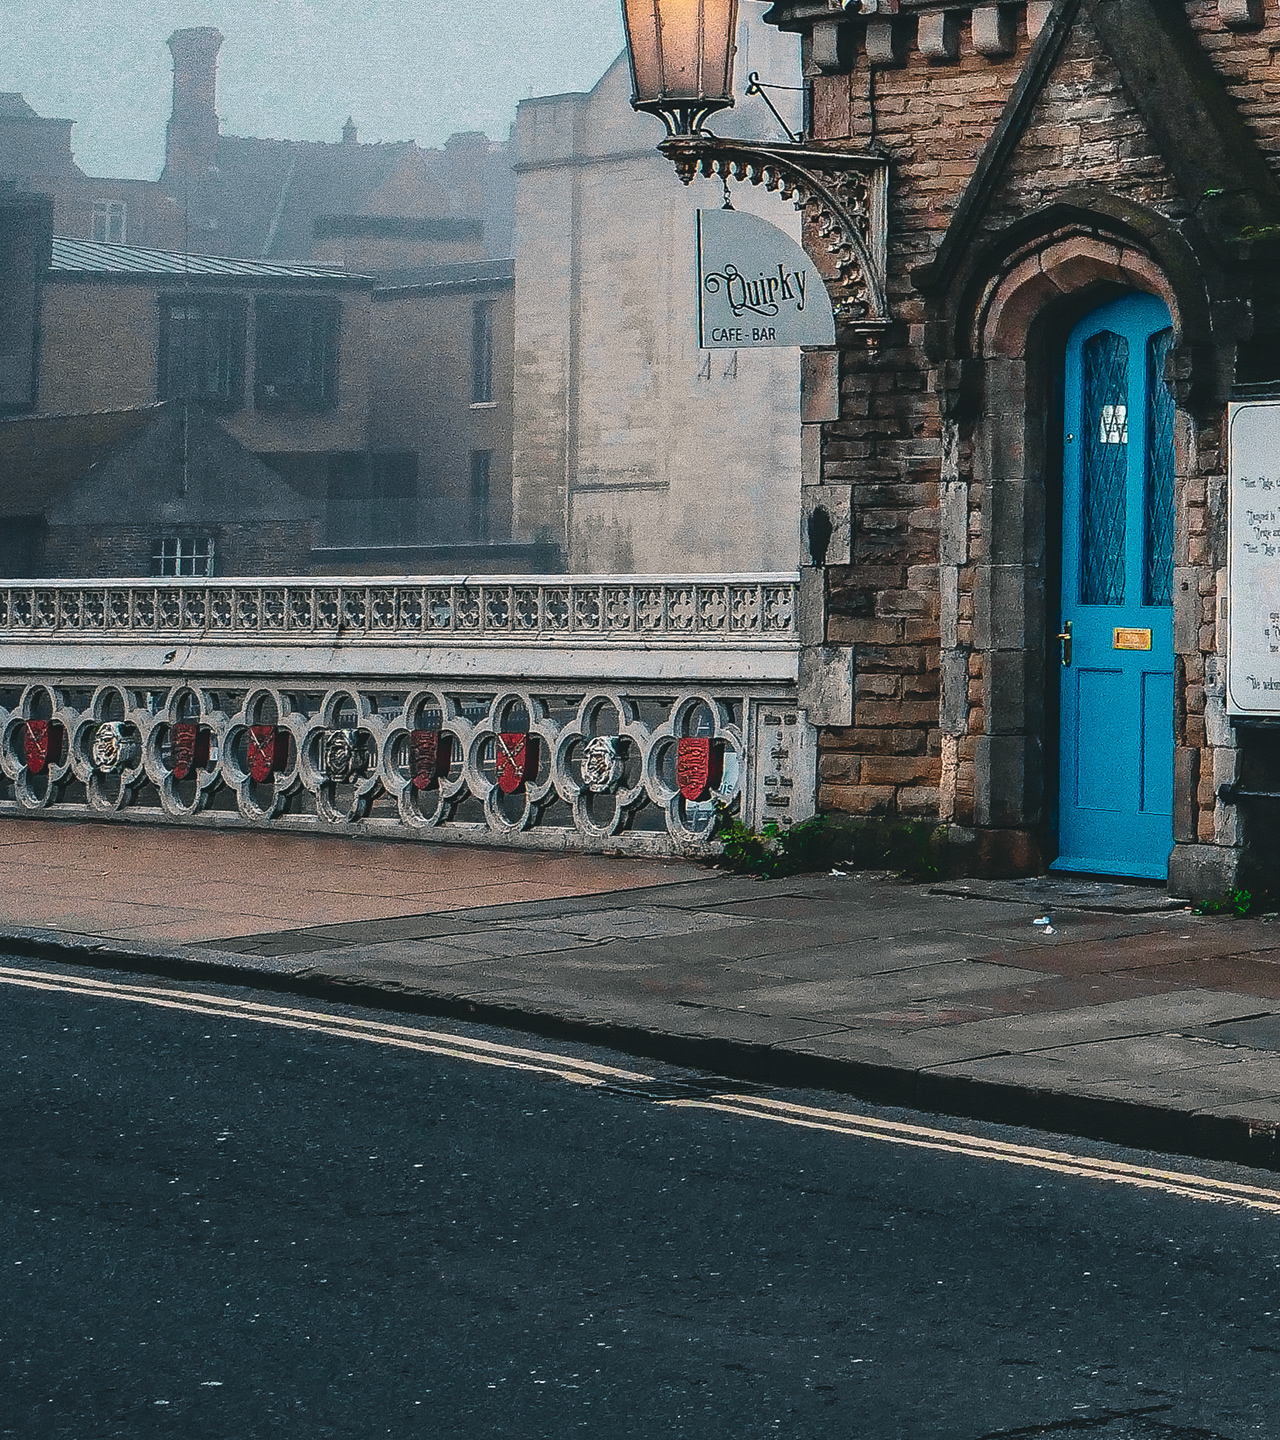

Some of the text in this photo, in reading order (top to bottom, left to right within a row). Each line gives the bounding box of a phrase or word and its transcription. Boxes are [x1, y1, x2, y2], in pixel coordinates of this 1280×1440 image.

[704, 263, 806, 317] Quirky
[712, 328, 742, 342] CAFE
[752, 327, 776, 341] BAR
